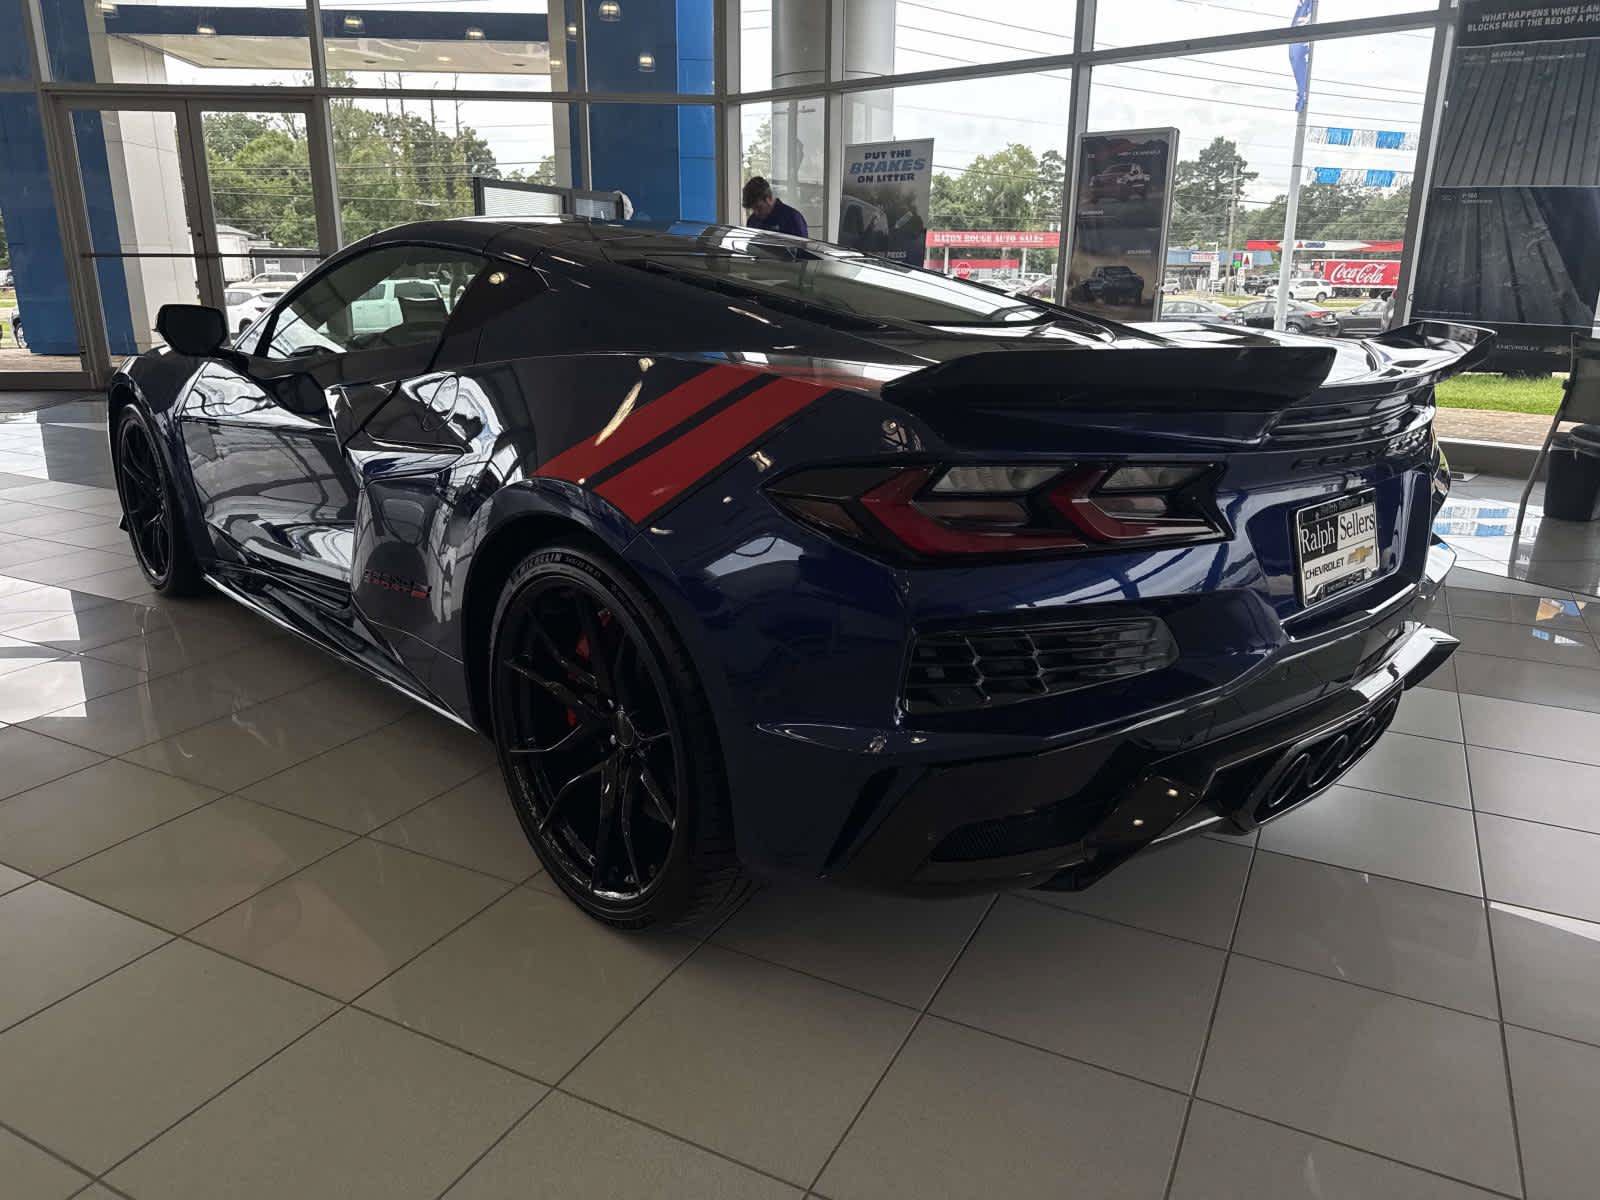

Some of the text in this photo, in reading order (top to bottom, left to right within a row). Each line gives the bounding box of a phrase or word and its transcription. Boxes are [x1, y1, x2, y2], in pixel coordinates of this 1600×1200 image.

[1482, 13, 1506, 23] WHAT
[1508, 8, 1549, 21] HAPPENS
[1551, 5, 1578, 16] WHEN
[1467, 20, 1501, 33] BLOCKS
[1501, 19, 1525, 29] MEET
[1527, 17, 1544, 27] THE
[1544, 15, 1562, 25] BED
[1564, 14, 1577, 24] OF
[1577, 13, 1585, 23] A
[864, 149, 912, 160] PUT THE
[850, 158, 926, 174] BRAKES
[857, 173, 914, 184] ON LITTER
[964, 234, 992, 243] ROUGE
[995, 234, 1017, 242] AUTO
[1301, 511, 1375, 555] Ralph Sellers
[1305, 557, 1345, 580] CHEVROLET
